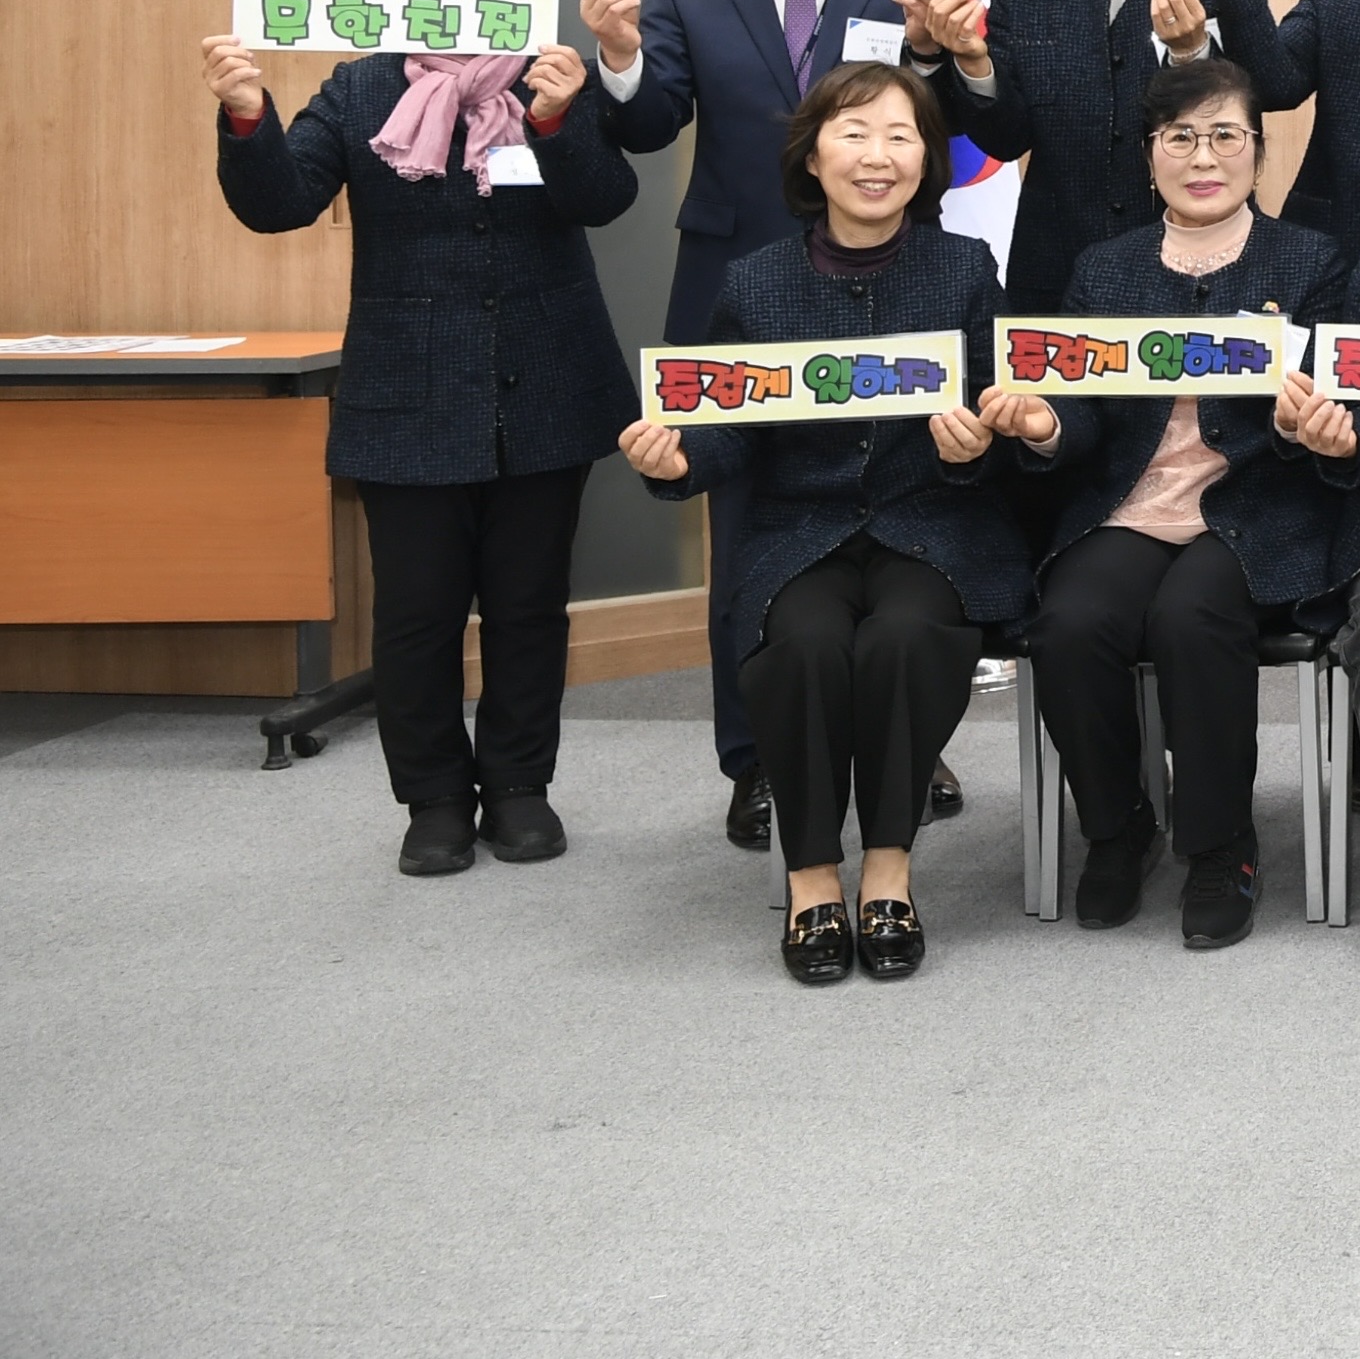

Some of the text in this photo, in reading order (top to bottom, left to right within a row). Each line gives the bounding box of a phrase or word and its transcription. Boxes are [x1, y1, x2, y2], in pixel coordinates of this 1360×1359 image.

[656, 353, 947, 412] 즐겁게 일하자
[1006, 328, 1272, 382] 즐겁게 일하자
